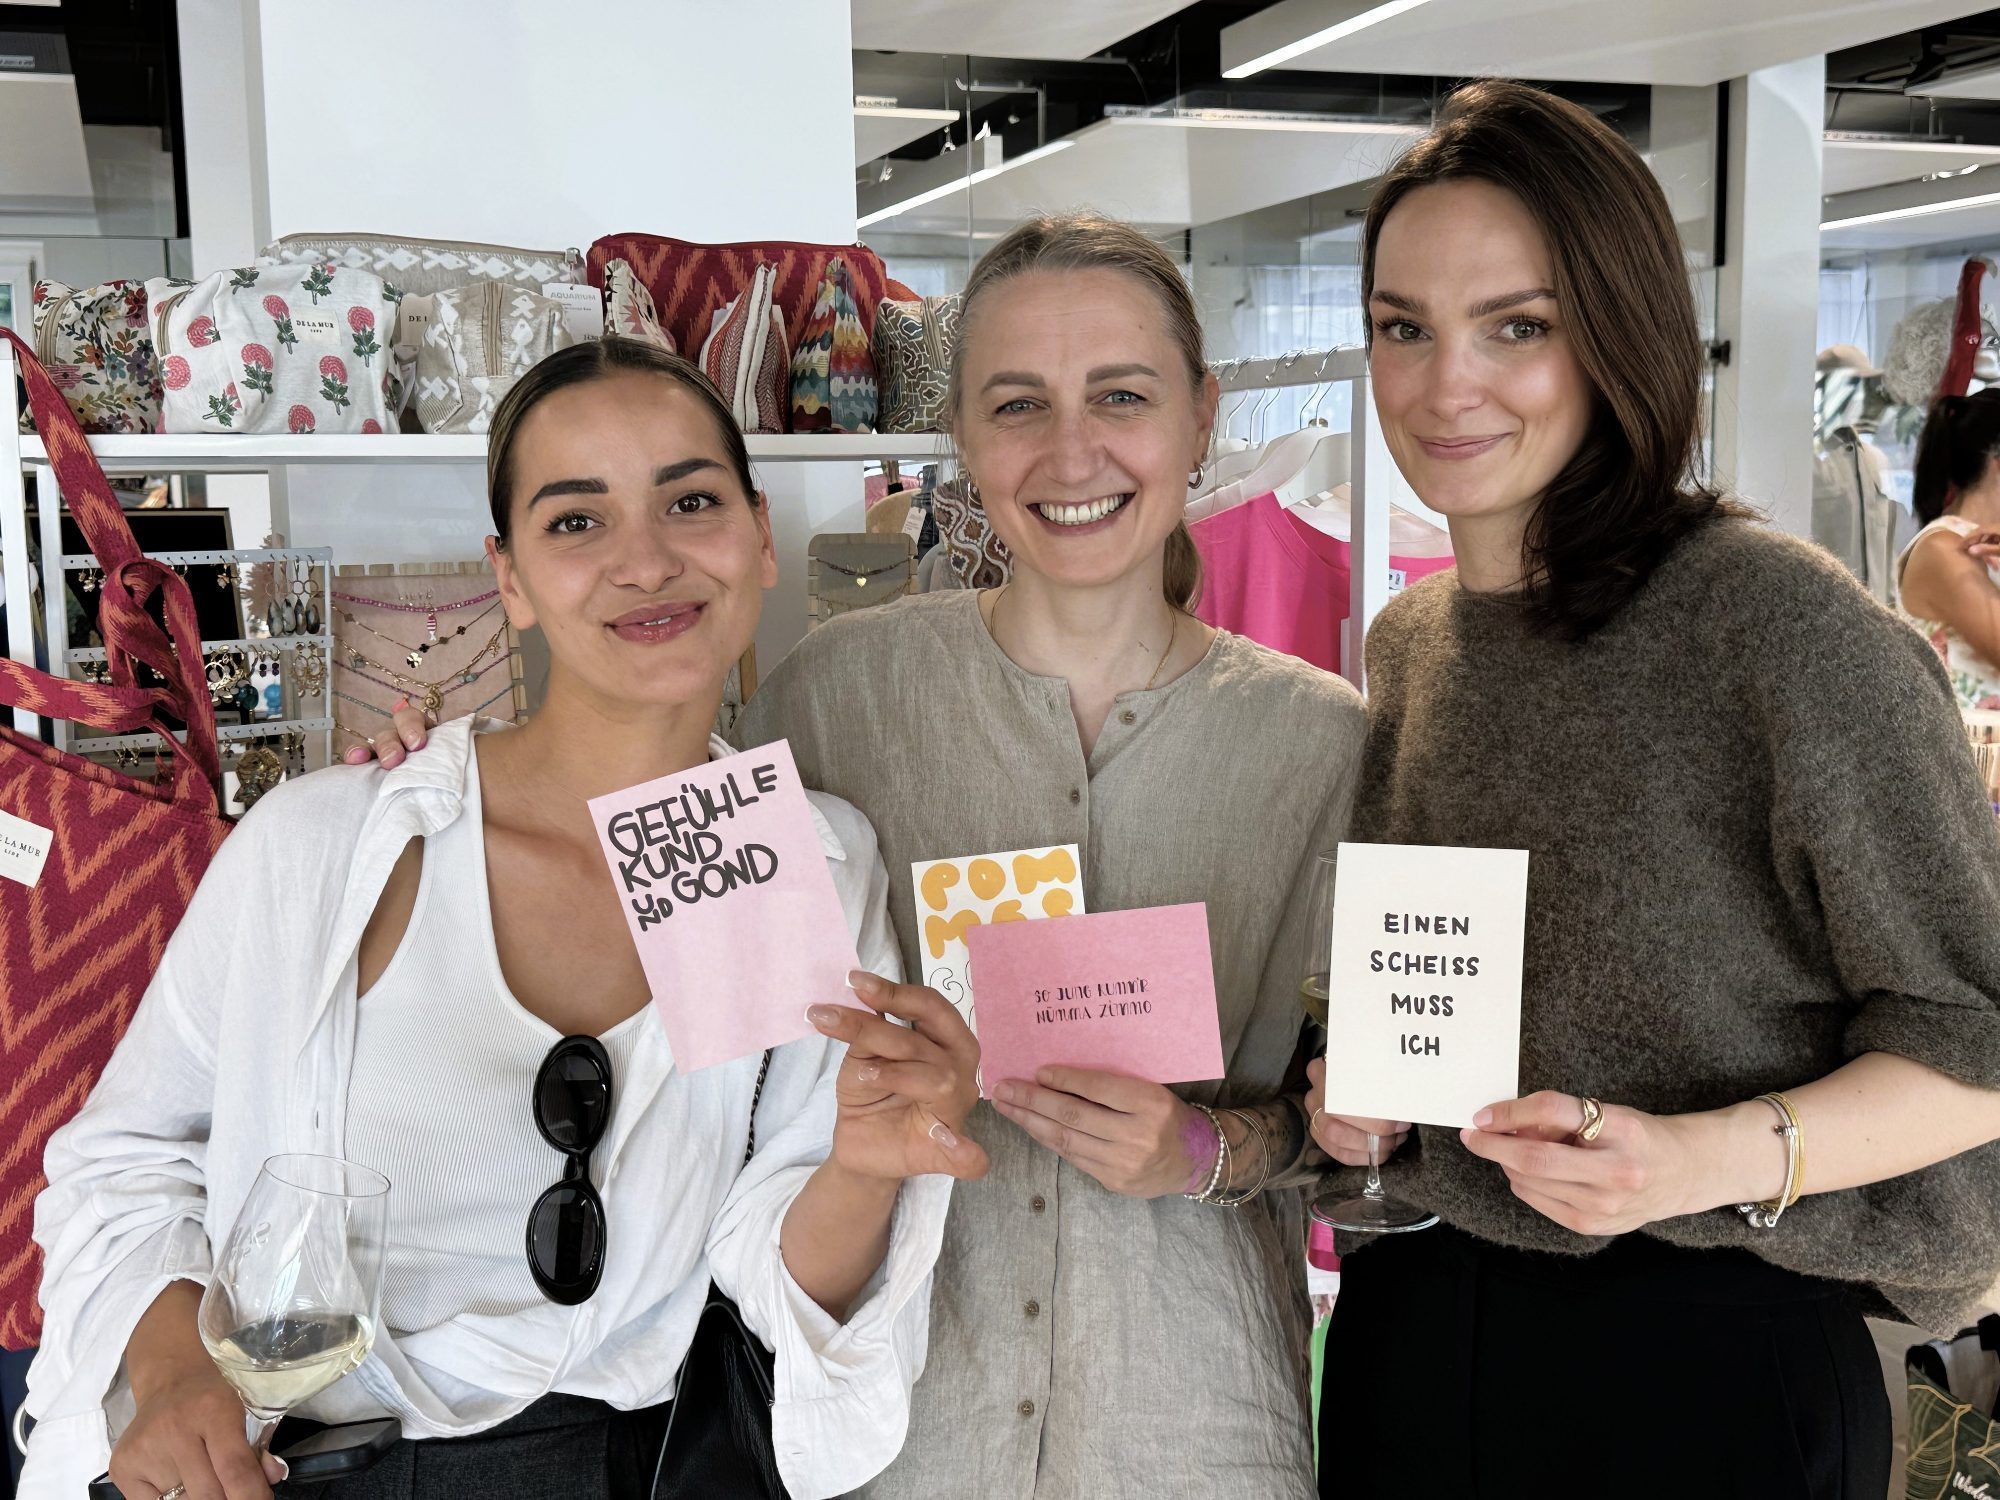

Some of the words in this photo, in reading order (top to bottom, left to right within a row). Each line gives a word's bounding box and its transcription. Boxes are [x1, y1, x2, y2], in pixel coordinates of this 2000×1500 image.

[607, 763, 778, 858] GEFÜHLE
[618, 831, 723, 893] KUND
[631, 893, 674, 932] UND
[671, 843, 779, 904] GOND
[1383, 912, 1470, 936] EINEN
[1370, 949, 1480, 977] SCHEISS
[1034, 989, 1051, 1003] SO
[1056, 984, 1092, 1001] JUNG
[1391, 992, 1454, 1017] MUSS
[1400, 1033, 1441, 1057] ICH
